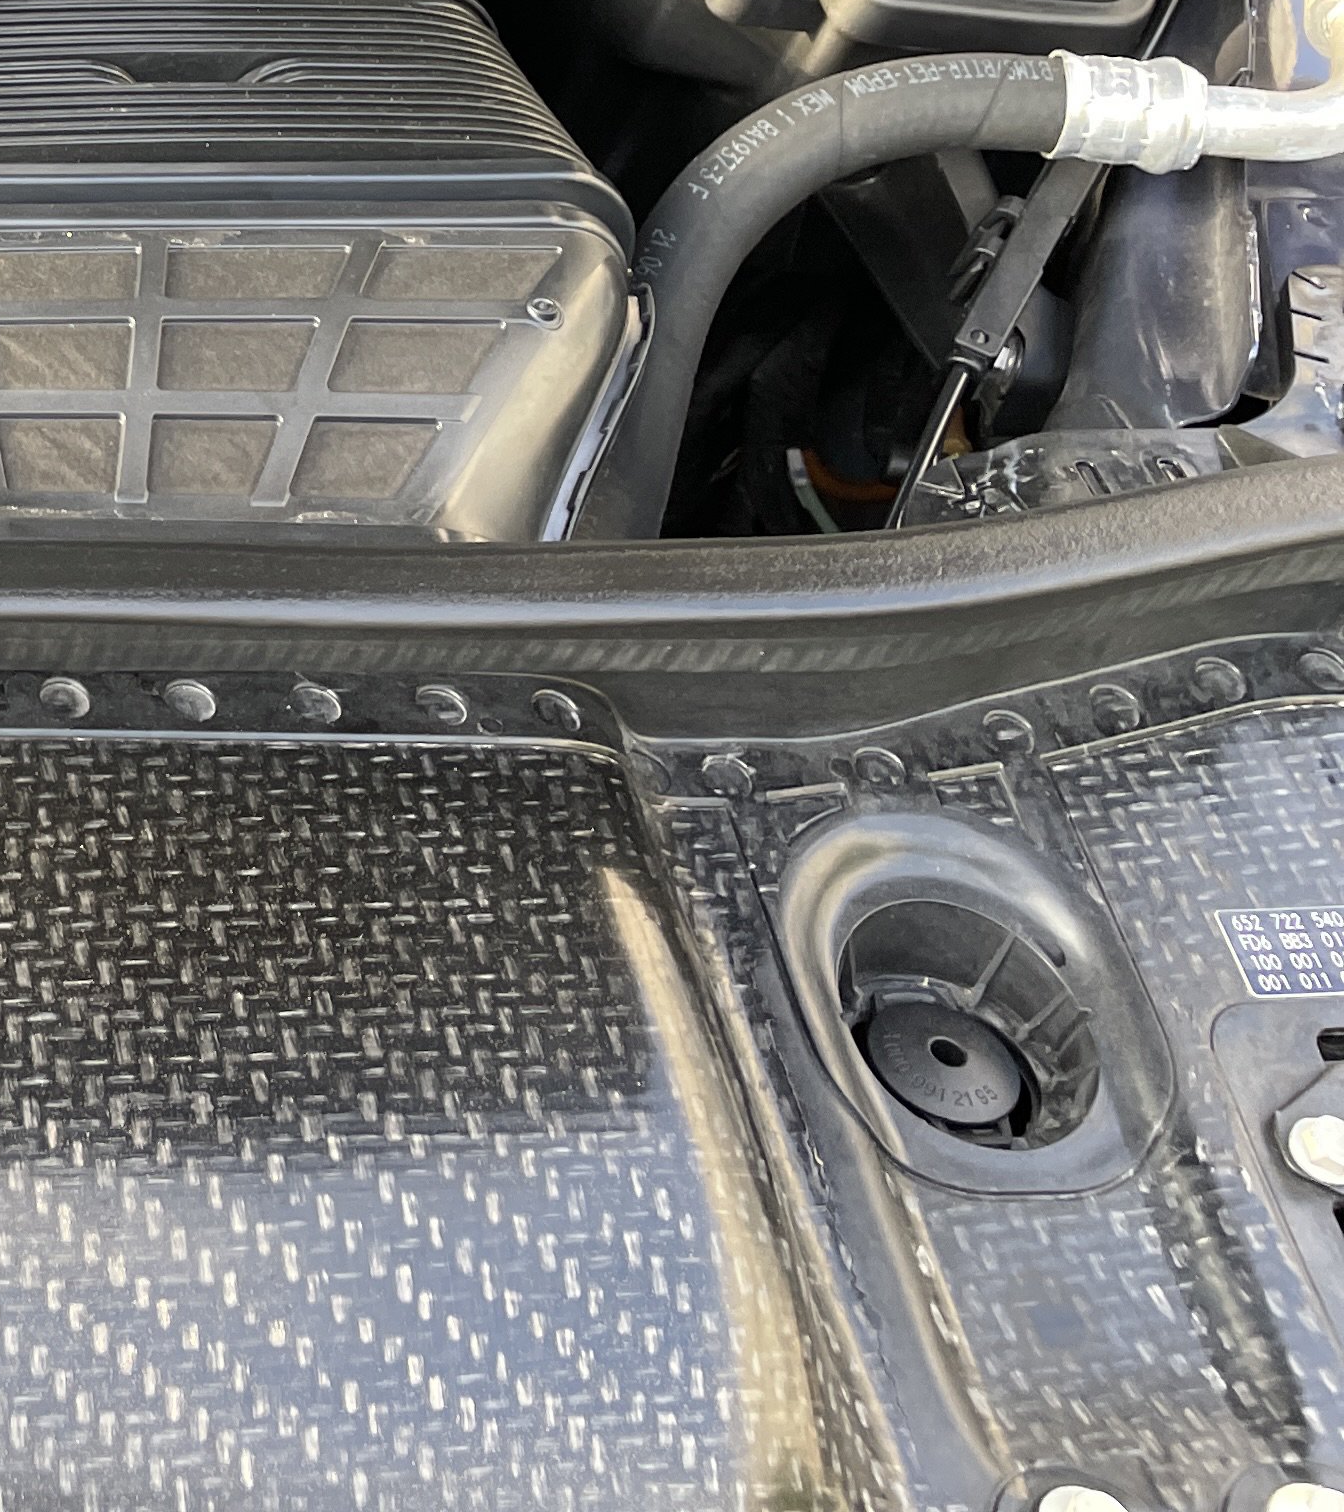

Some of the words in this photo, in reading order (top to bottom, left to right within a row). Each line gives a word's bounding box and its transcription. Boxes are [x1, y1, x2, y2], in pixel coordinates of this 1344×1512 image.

[791, 87, 836, 116] MEX
[687, 182, 710, 200] F
[1231, 914, 1264, 932] 652
[1269, 912, 1305, 930] 722
[1250, 953, 1283, 971] 100
[1289, 952, 1323, 970] 001
[1257, 973, 1292, 992] 001
[1298, 971, 1333, 990] 011
